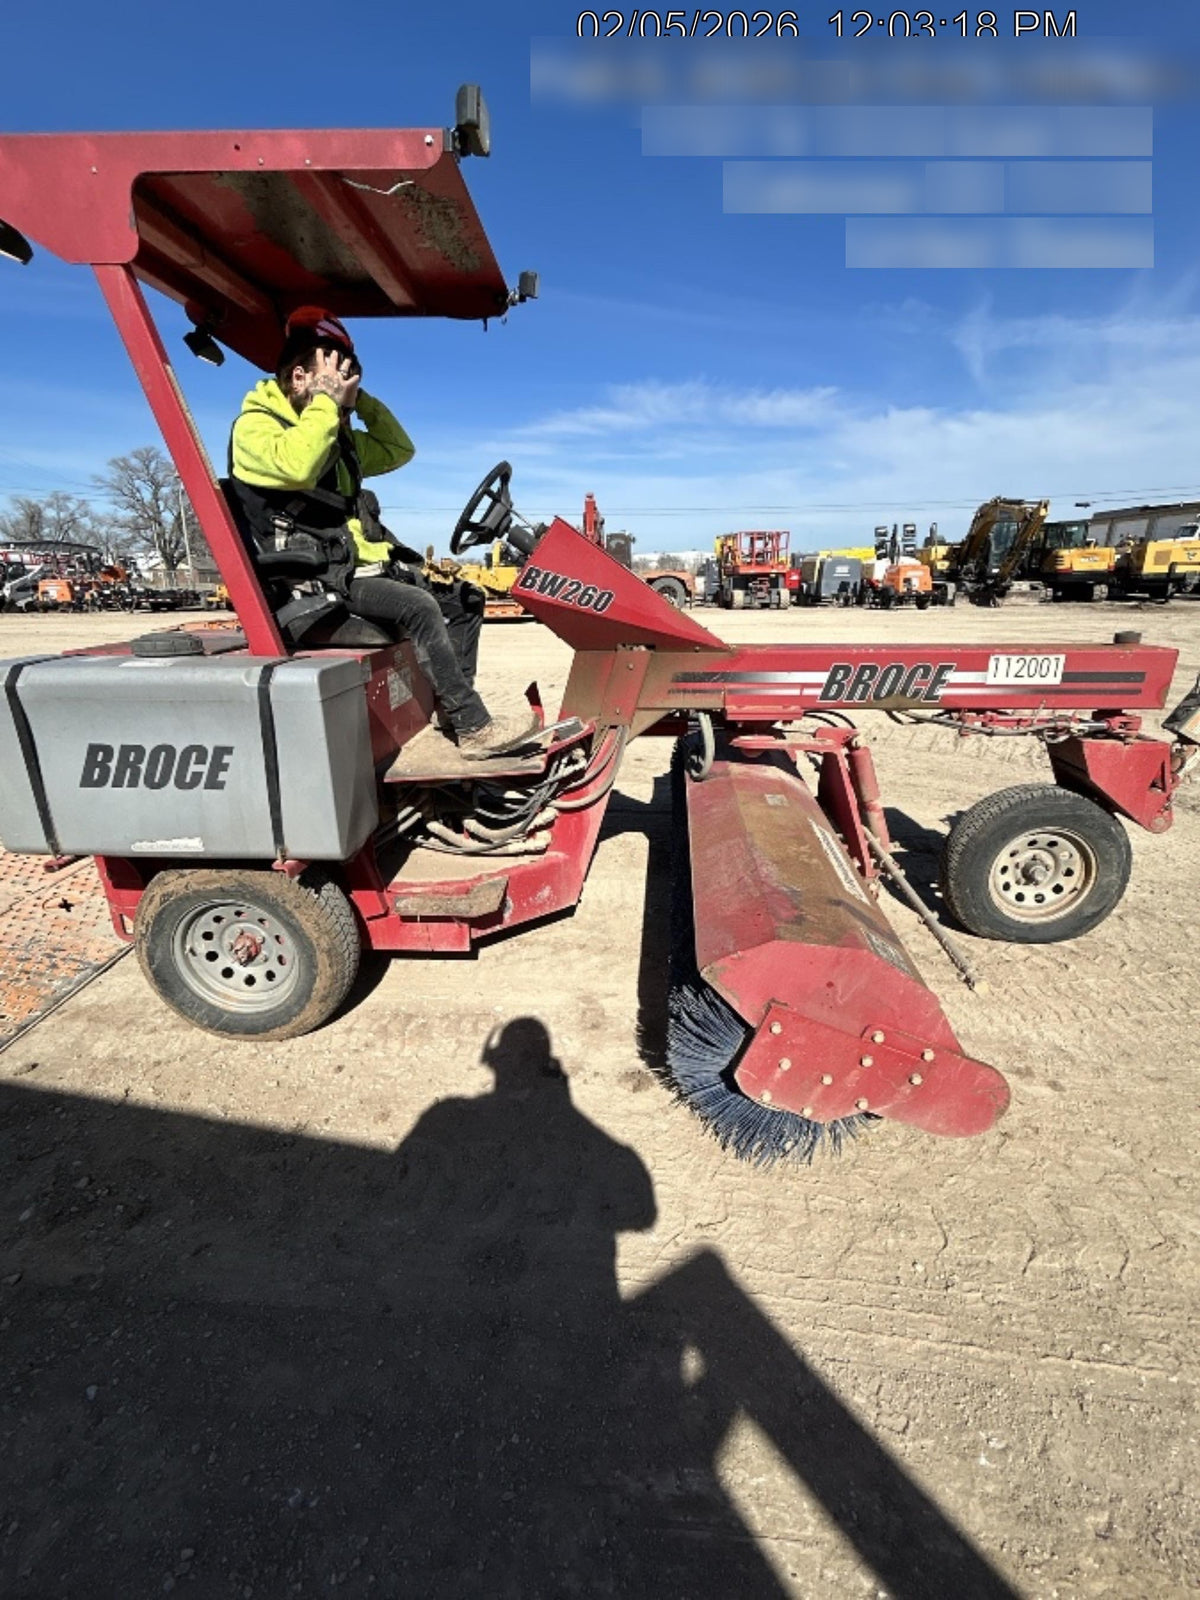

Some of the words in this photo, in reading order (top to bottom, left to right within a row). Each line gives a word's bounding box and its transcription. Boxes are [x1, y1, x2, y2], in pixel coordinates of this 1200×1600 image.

[518, 565, 616, 614] BW260
[817, 663, 957, 702] BROCE
[993, 657, 1060, 678] 112001
[79, 743, 235, 790] BROCE
